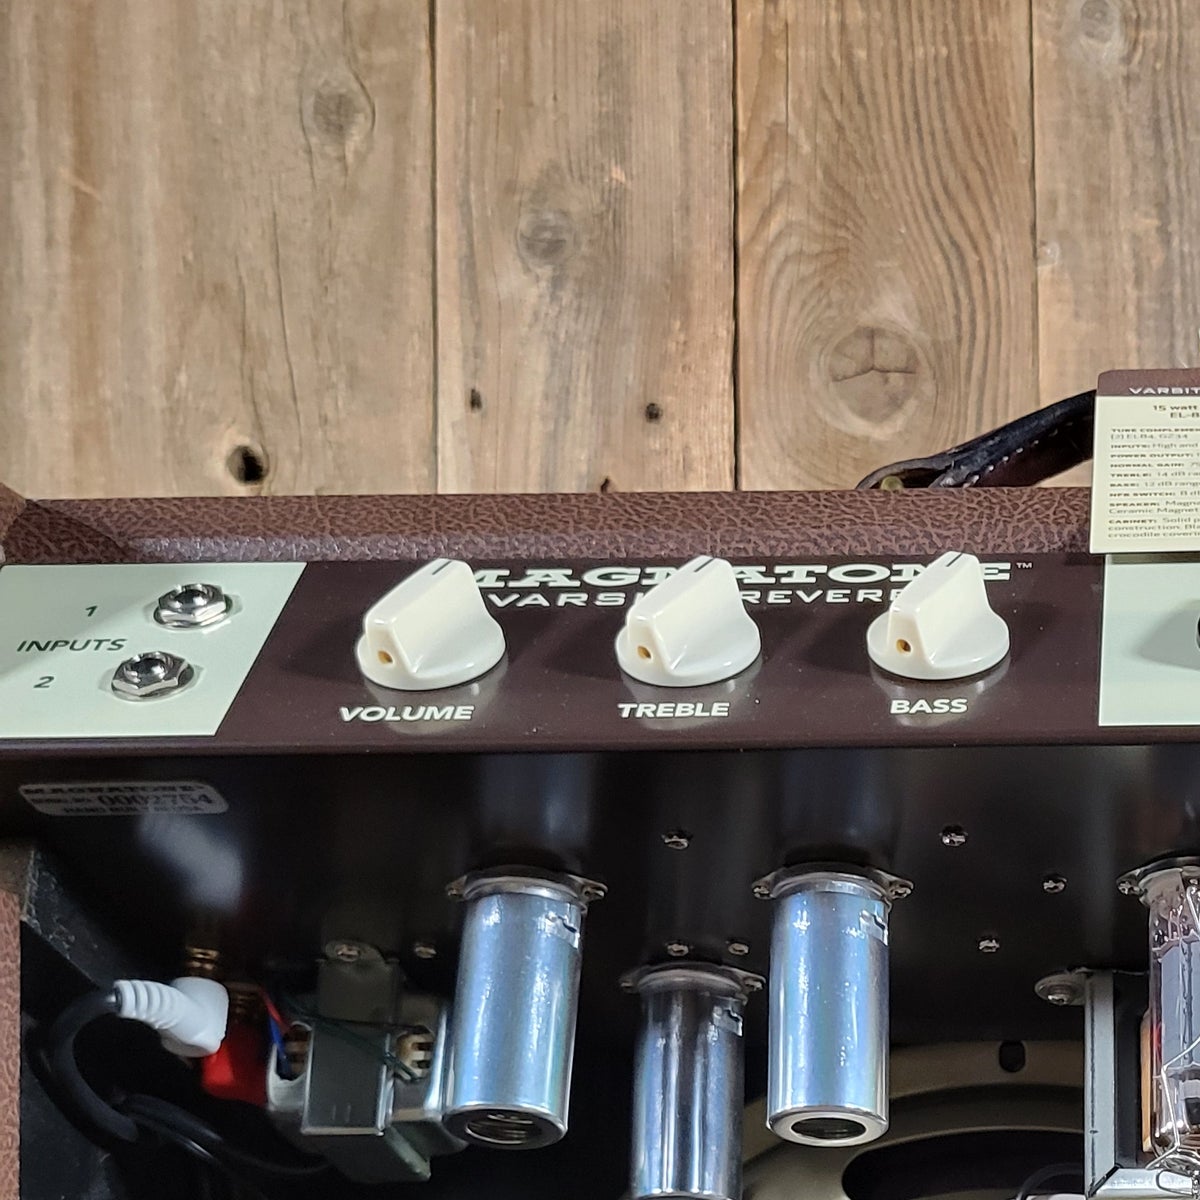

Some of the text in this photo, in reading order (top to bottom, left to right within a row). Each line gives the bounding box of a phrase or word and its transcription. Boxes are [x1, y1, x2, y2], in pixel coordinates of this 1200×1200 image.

[488, 592, 647, 608] VARSI
[85, 605, 97, 618] 1
[17, 638, 127, 652] INPUTS
[34, 676, 55, 689] 2
[339, 705, 475, 723] VOLUME
[618, 702, 730, 719] TREBLE
[890, 698, 969, 714] BASS
